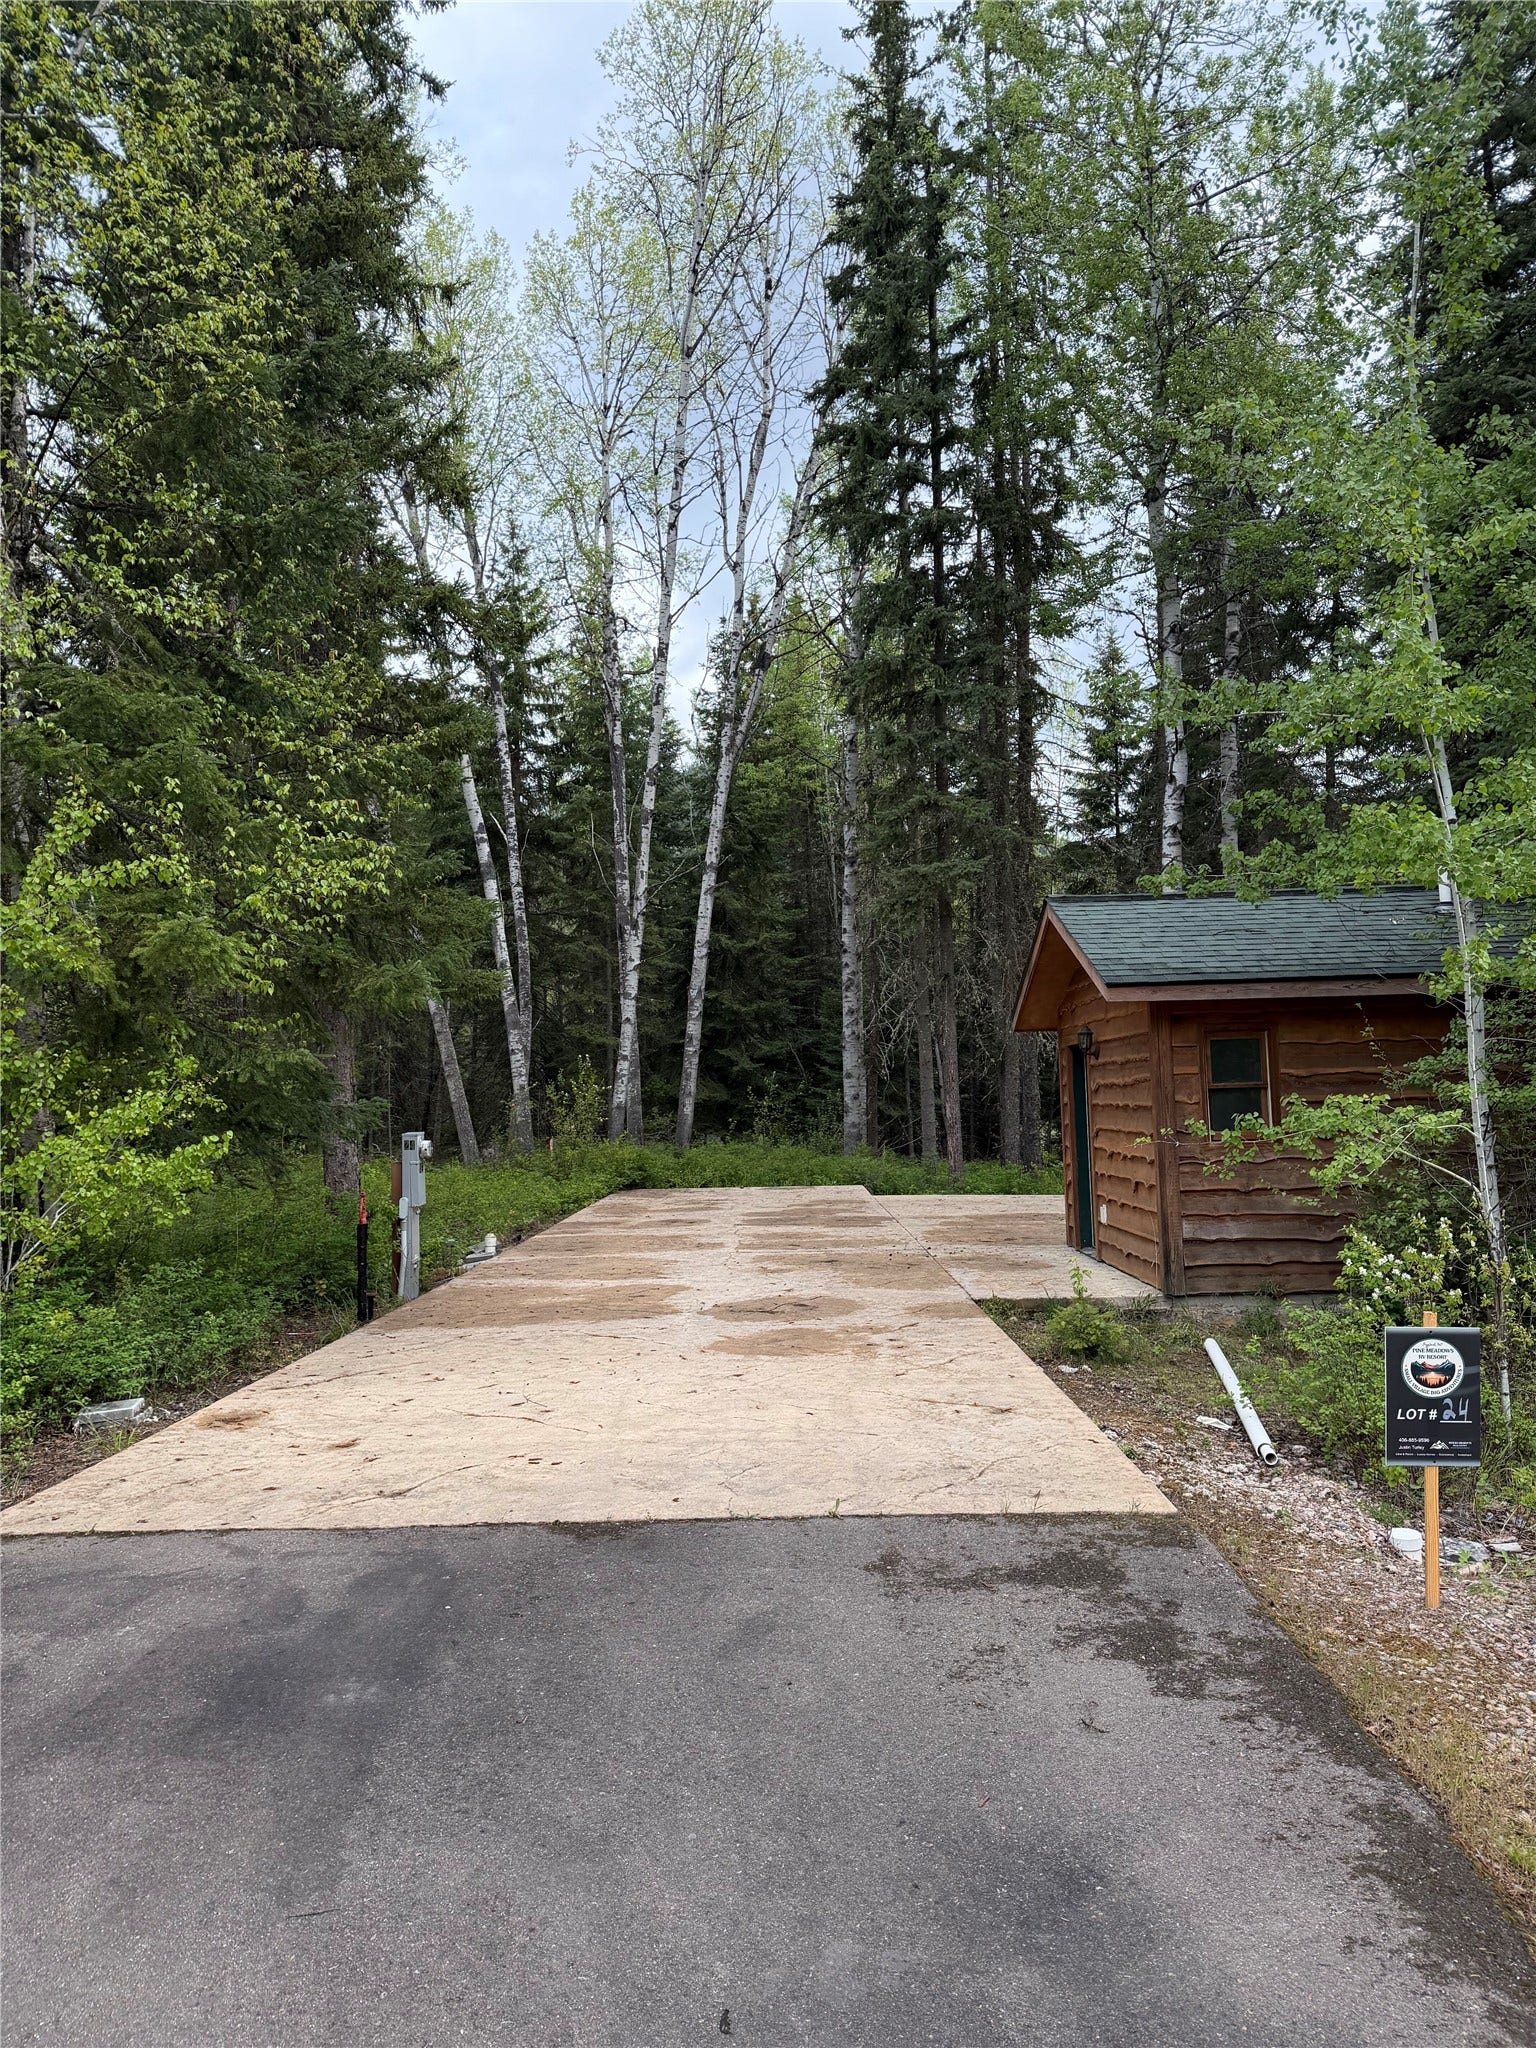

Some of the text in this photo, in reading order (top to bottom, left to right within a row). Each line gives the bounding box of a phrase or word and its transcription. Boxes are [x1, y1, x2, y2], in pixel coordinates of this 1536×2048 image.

[1411, 1382, 1430, 1395] VILLAGE
[1396, 1397, 1469, 1422] LOT # 24
